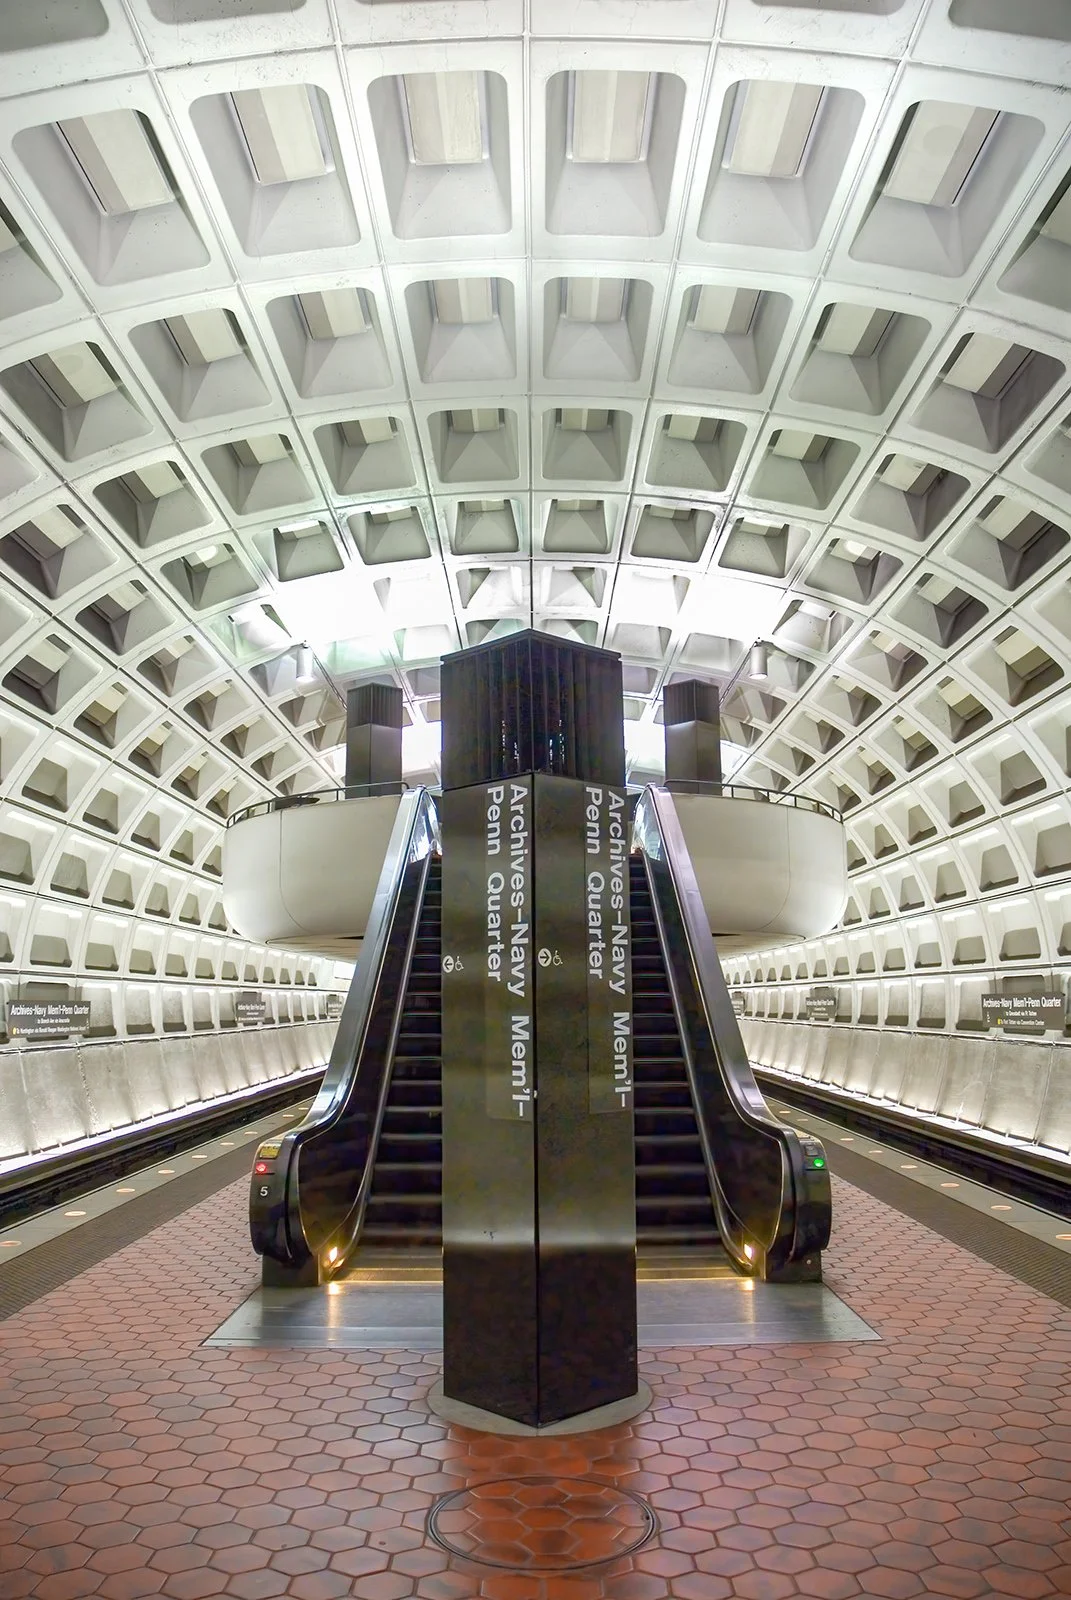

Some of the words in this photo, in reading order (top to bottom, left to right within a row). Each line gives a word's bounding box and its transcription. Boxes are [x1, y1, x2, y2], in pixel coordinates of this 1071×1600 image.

[487, 785, 504, 856] Penn
[585, 786, 603, 855] Penn
[487, 871, 505, 982] Quarter
[507, 783, 529, 998] Archives-Navy
[587, 871, 606, 980] Quarter
[608, 790, 629, 995] Archives-Navy
[74, 1004, 90, 1015] Quarter
[1041, 996, 1061, 1008] Quarter
[511, 1015, 531, 1117] Mem'l-
[613, 1011, 632, 1108] Mem'l-
[260, 1186, 269, 1197] 5
